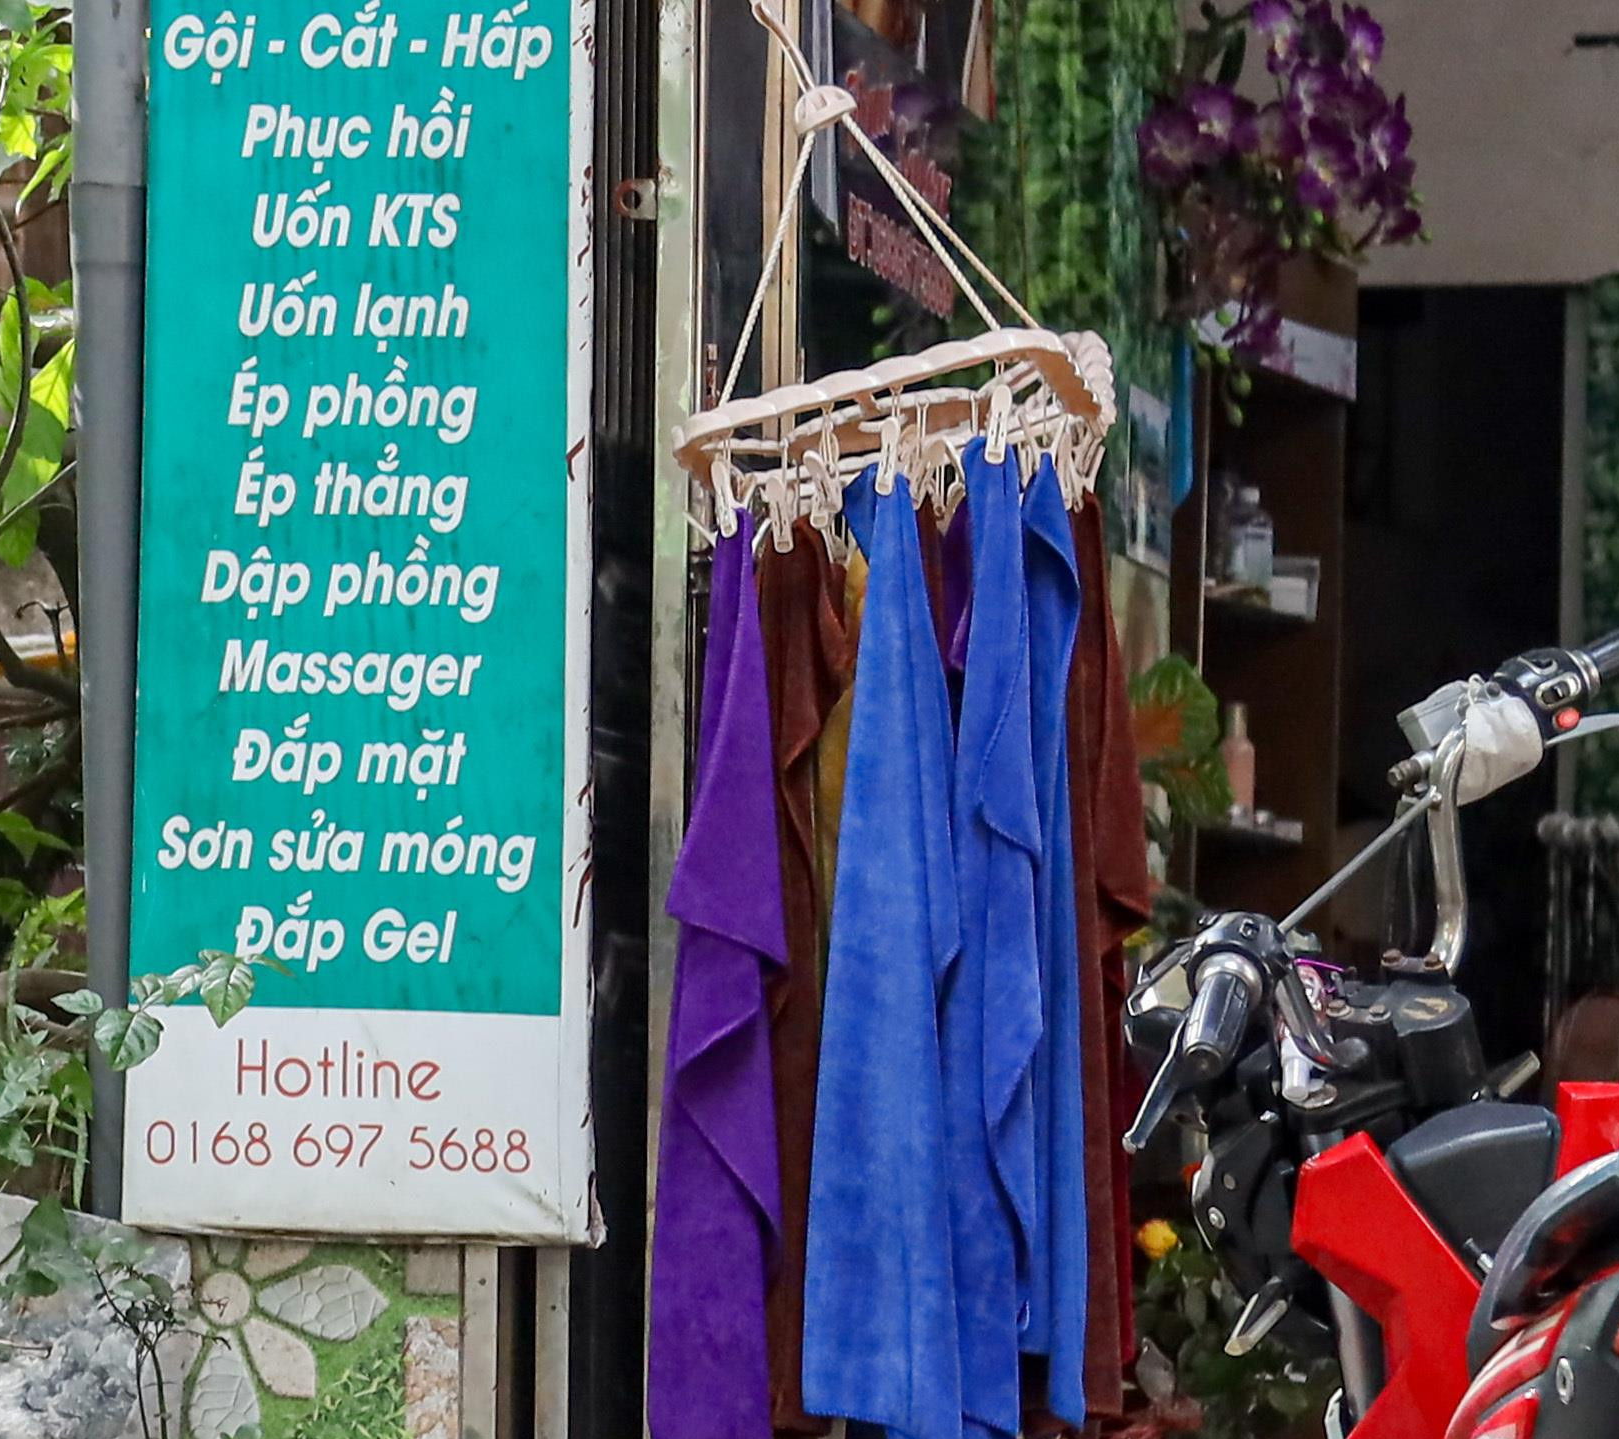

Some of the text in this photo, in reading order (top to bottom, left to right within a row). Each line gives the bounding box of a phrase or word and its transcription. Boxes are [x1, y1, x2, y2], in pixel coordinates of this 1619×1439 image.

[163, 11, 256, 85] Gội
[441, 0, 554, 79] Hấp
[241, 86, 472, 174] Phục hồi
[252, 181, 461, 248] Uốn KTS
[238, 271, 470, 353] Uốn lạnh
[228, 356, 478, 445] Ép phồng
[234, 444, 469, 533] Ép thẳng
[201, 534, 500, 622] Dập phồng
[219, 639, 482, 712] Massager
[232, 713, 467, 801] Đắp mặt
[158, 810, 536, 893] Sơn sửa móng
[235, 890, 457, 972] Đắp Gel
[235, 1038, 442, 1101] Hotline
[146, 1118, 532, 1174] 0168 697 5688
